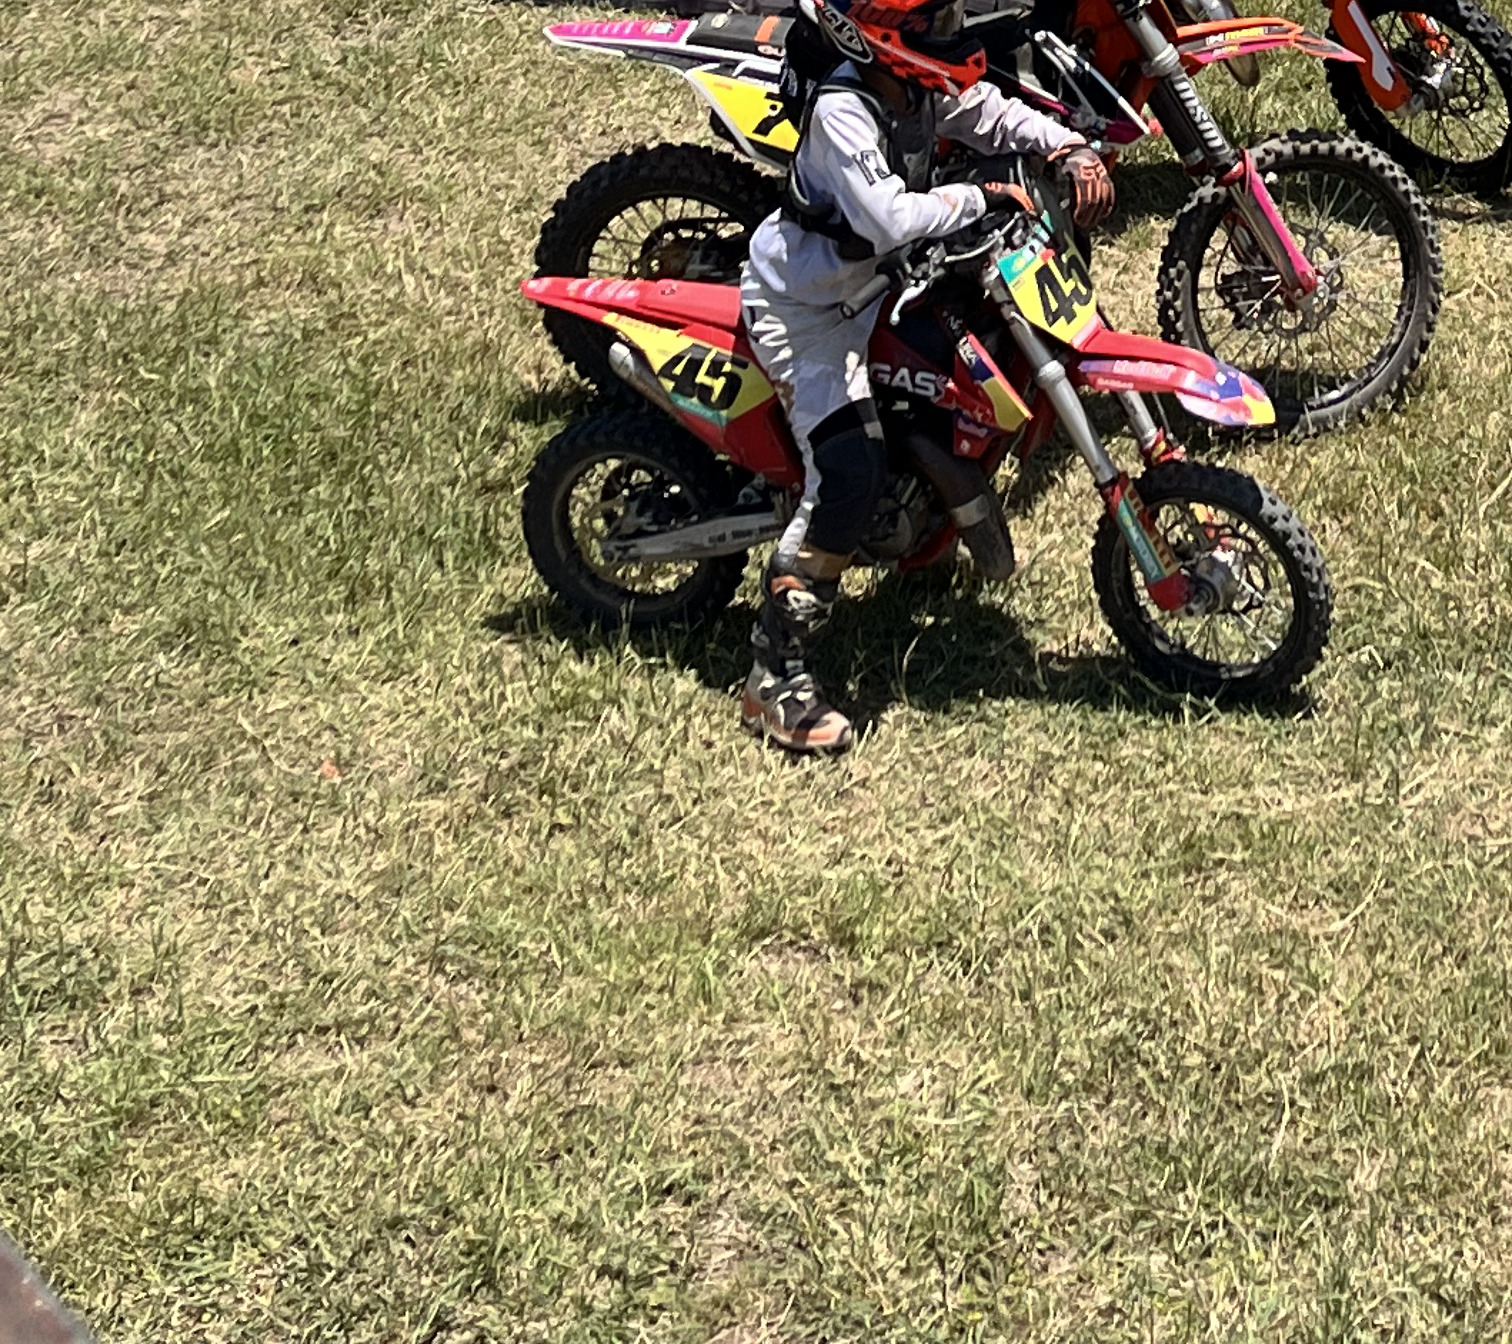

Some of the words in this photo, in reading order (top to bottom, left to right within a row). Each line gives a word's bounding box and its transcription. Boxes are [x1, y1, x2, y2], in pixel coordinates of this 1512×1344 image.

[1034, 255, 1093, 328] 45
[657, 342, 750, 412] 45
[869, 361, 937, 397] GAS
